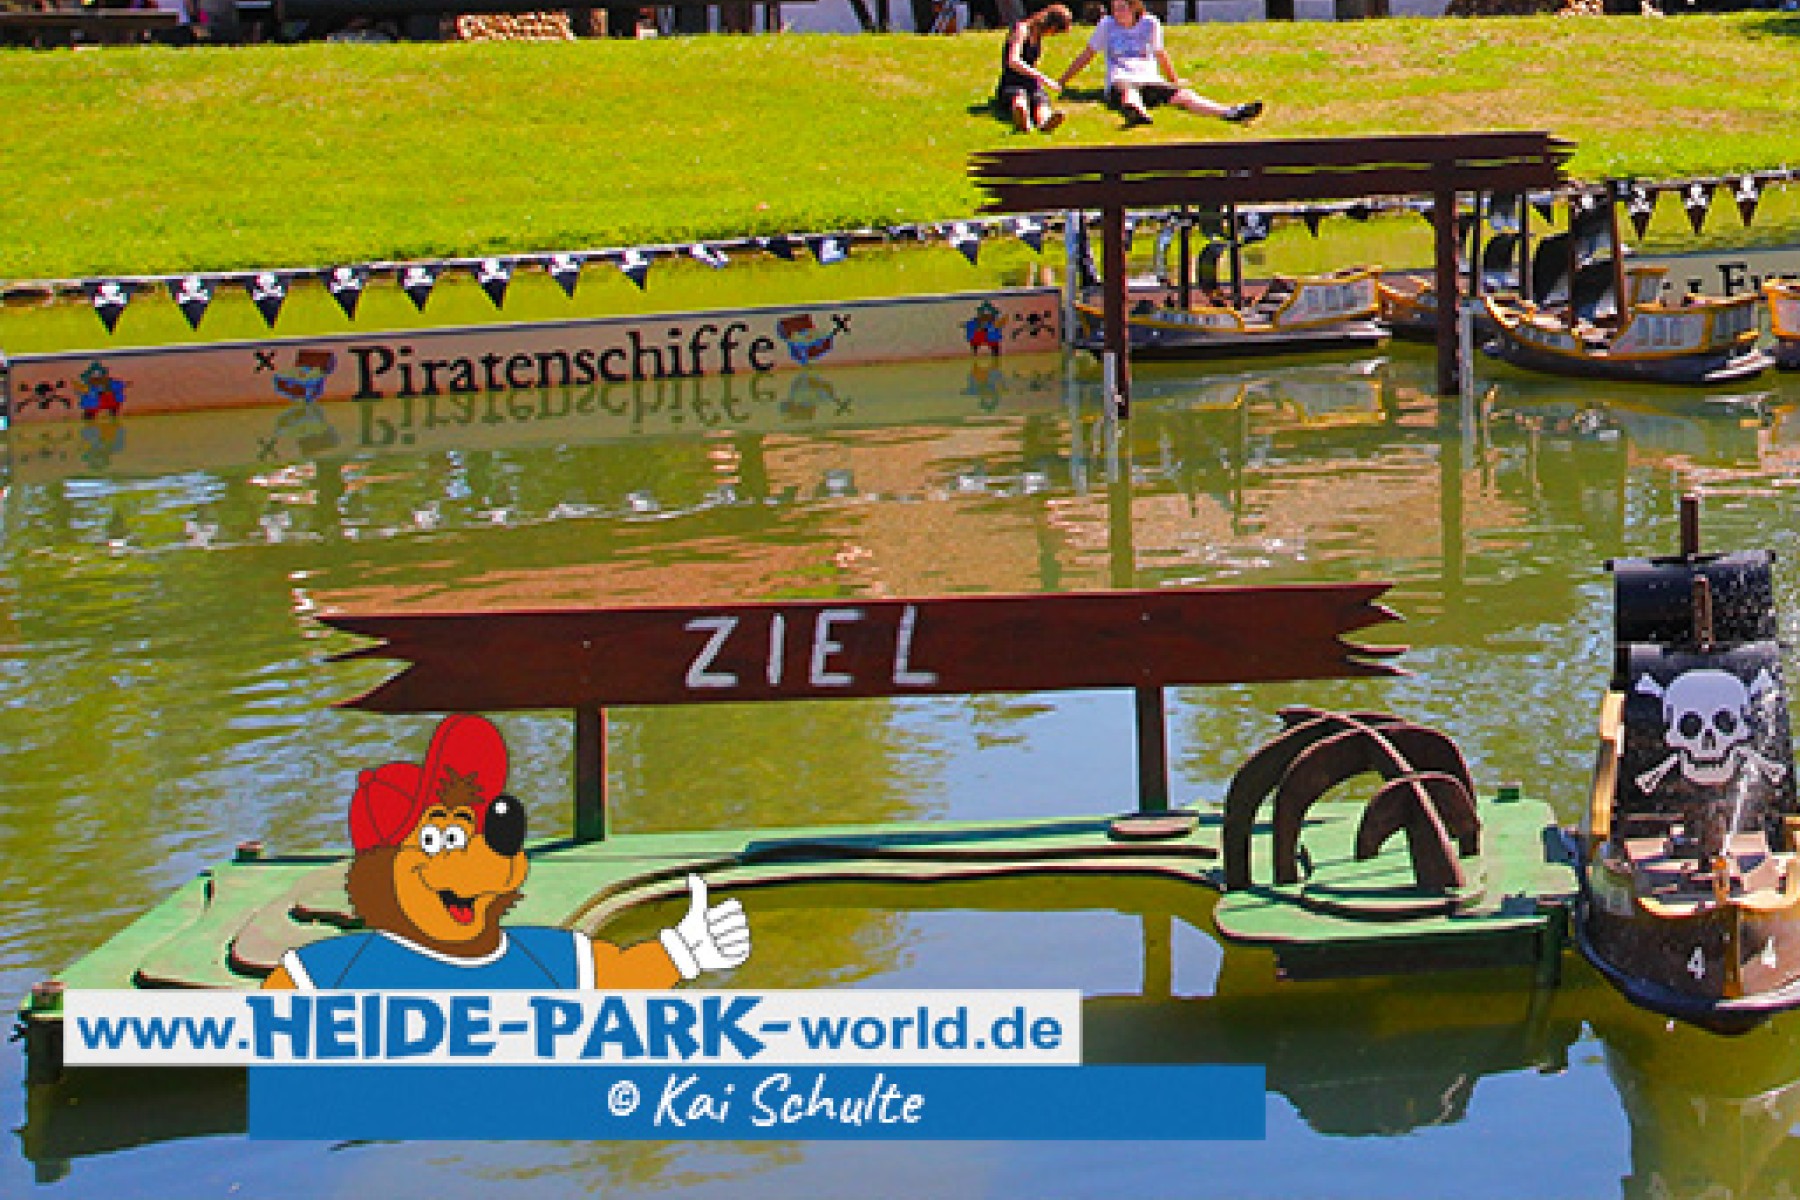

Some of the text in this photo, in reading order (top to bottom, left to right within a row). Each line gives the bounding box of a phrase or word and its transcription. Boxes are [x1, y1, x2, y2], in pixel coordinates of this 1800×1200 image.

[348, 322, 775, 399] Piratenschiffe
[683, 603, 939, 688] ZIEL
[1687, 947, 1706, 979] 4
